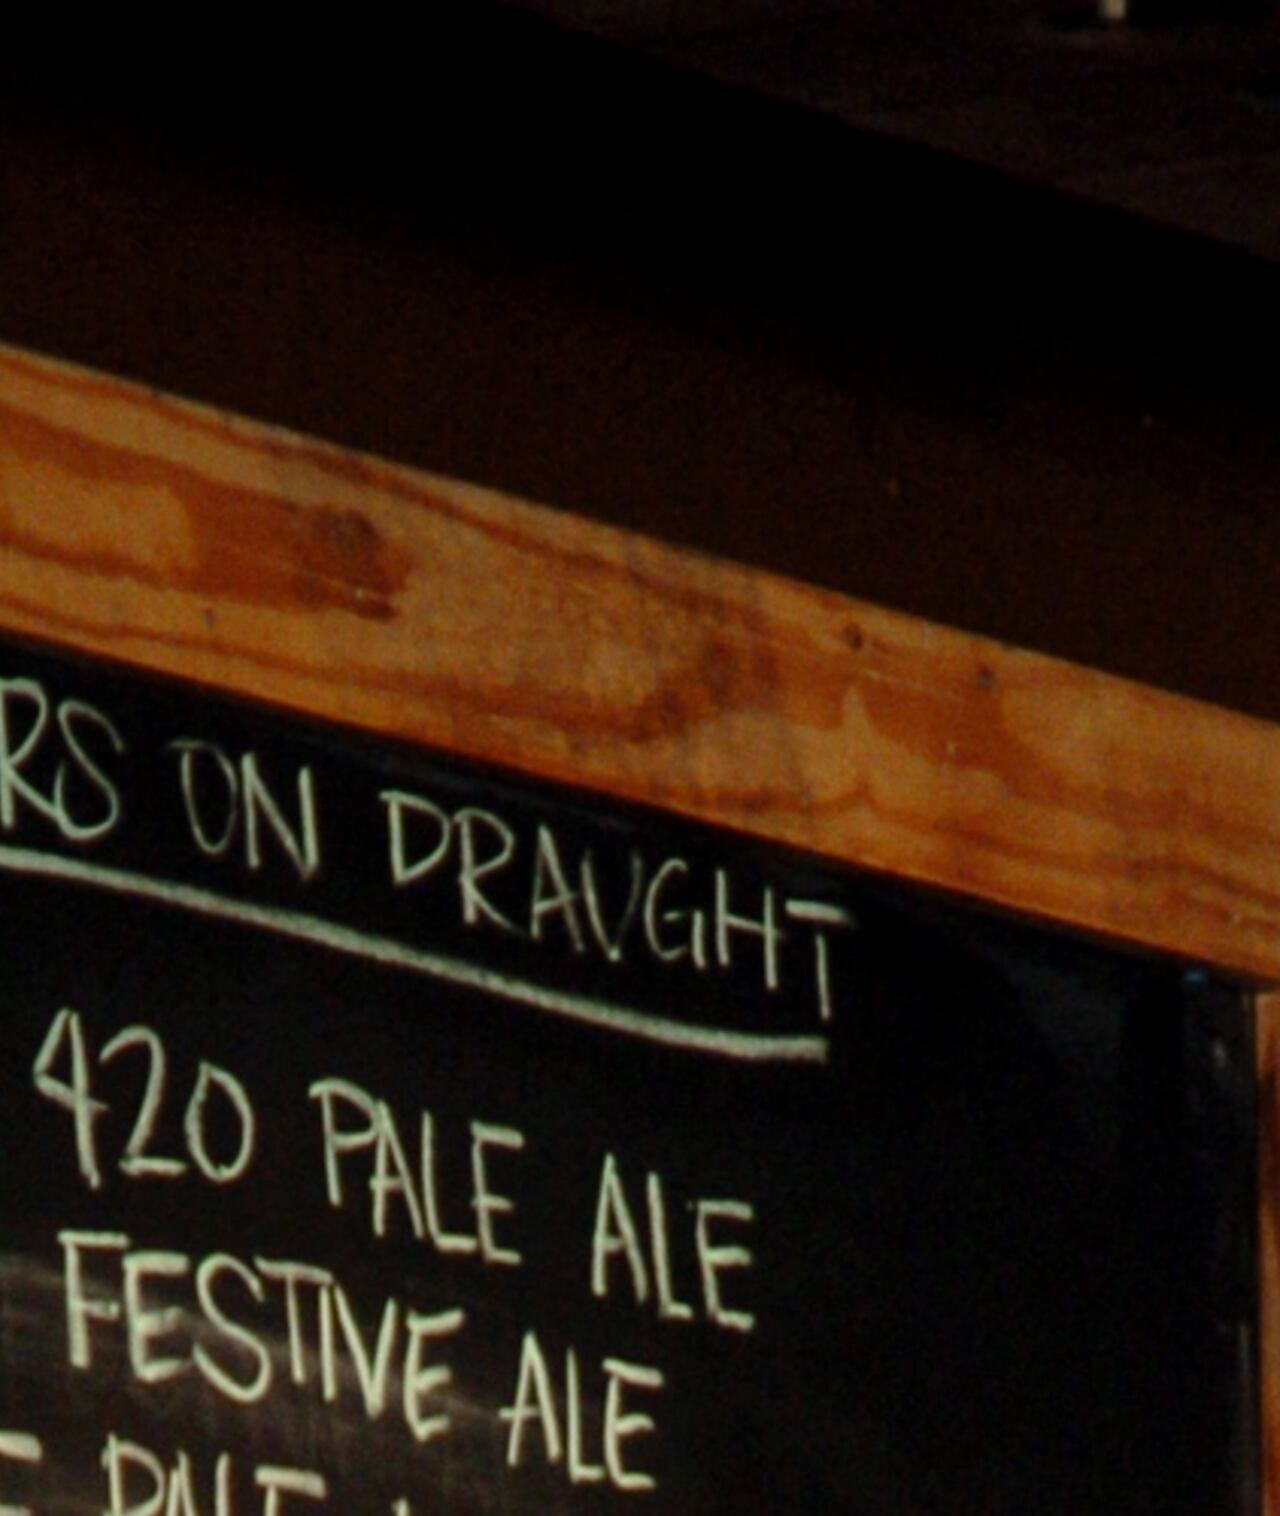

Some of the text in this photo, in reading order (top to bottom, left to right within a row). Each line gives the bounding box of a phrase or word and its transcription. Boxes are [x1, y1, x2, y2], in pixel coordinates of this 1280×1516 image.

[181, 743, 319, 877] ON
[380, 791, 845, 1019] DRAUGHT
[33, 1008, 255, 1189] 420
[308, 1077, 525, 1265] PALE
[591, 1153, 755, 1332] ALE
[58, 1229, 464, 1443] FESTIVE
[498, 1332, 664, 1491] ALE
